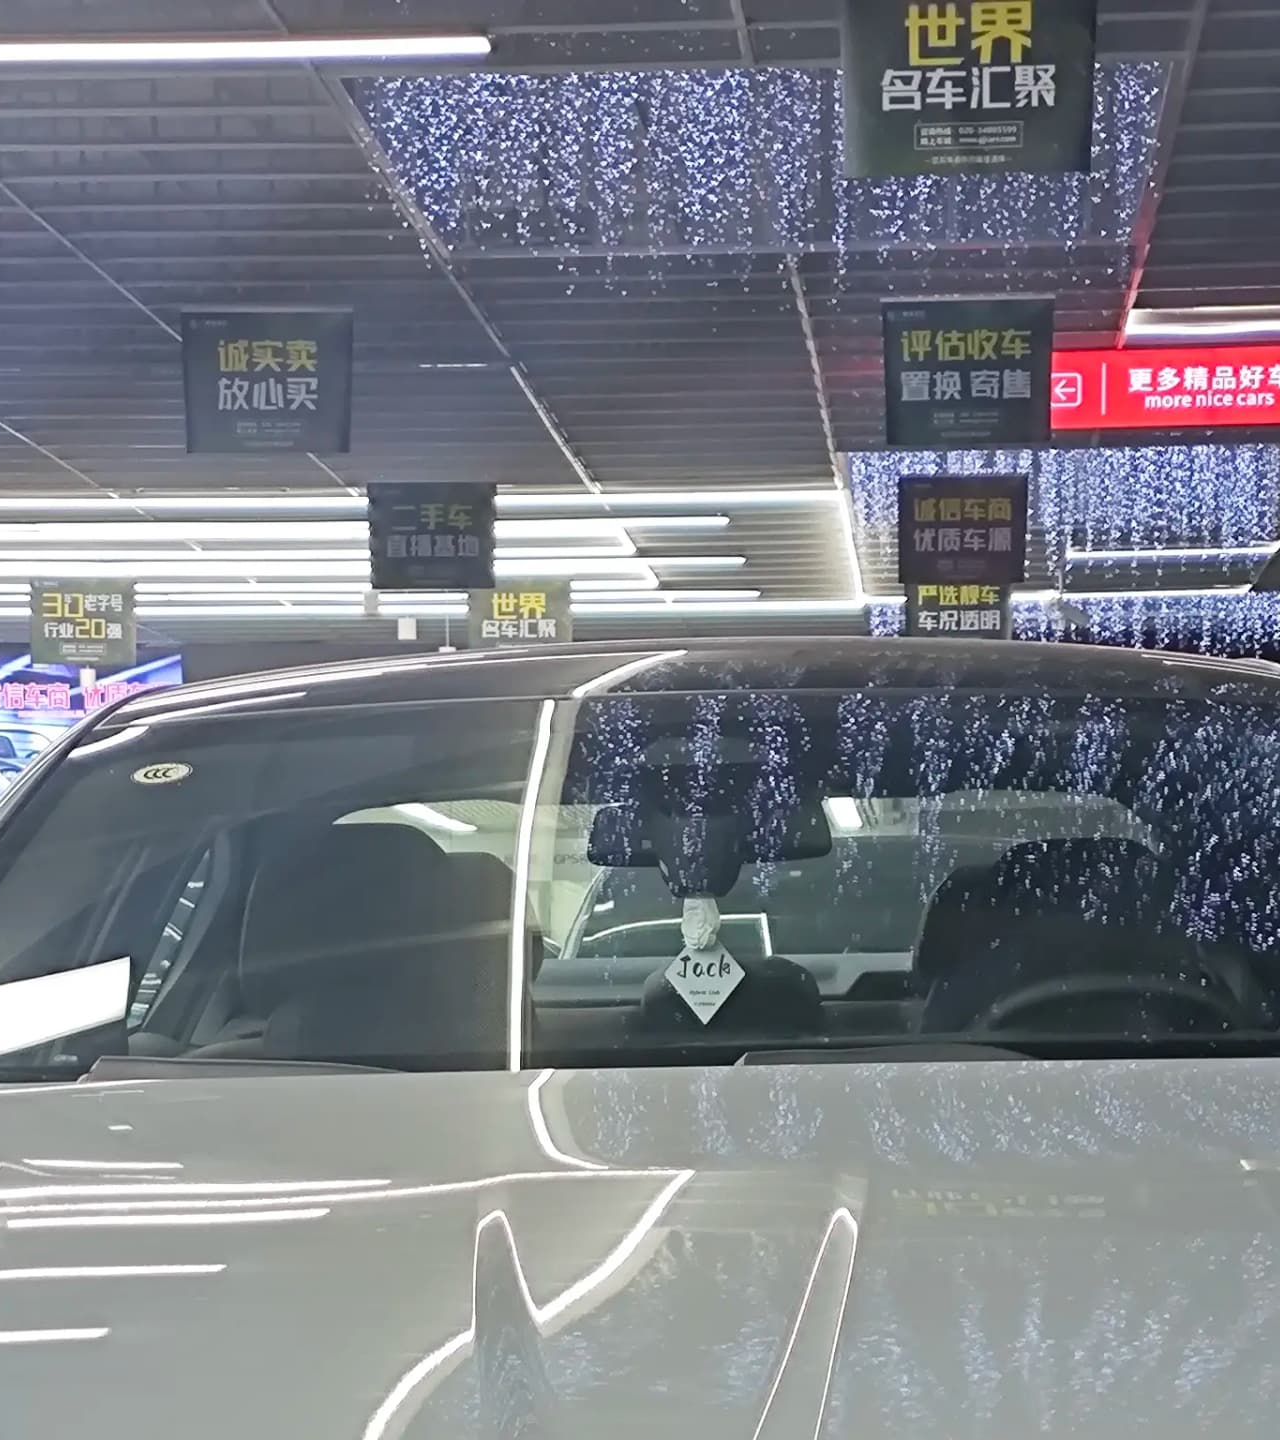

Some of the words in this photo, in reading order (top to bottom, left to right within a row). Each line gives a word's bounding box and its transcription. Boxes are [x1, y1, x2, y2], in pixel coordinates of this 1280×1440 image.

[905, 1, 1032, 66] 世界
[881, 64, 1056, 111] 名车汇聚
[218, 339, 317, 372] 诚实卖
[901, 329, 1032, 361] 评估收车
[218, 377, 318, 410] 放心买
[901, 370, 962, 401] 置换
[970, 369, 1031, 399] 寄售
[1145, 395, 1192, 408] more
[1196, 391, 1233, 407] nice
[1237, 393, 1275, 406] cars
[392, 503, 472, 530] 二手车
[914, 528, 1011, 552] 优质车源
[492, 593, 545, 619] 世界
[44, 619, 122, 639] 行业20强
[482, 620, 556, 638] 名车汇聚
[918, 611, 1000, 631] 车况透明
[677, 954, 730, 978] Jack
